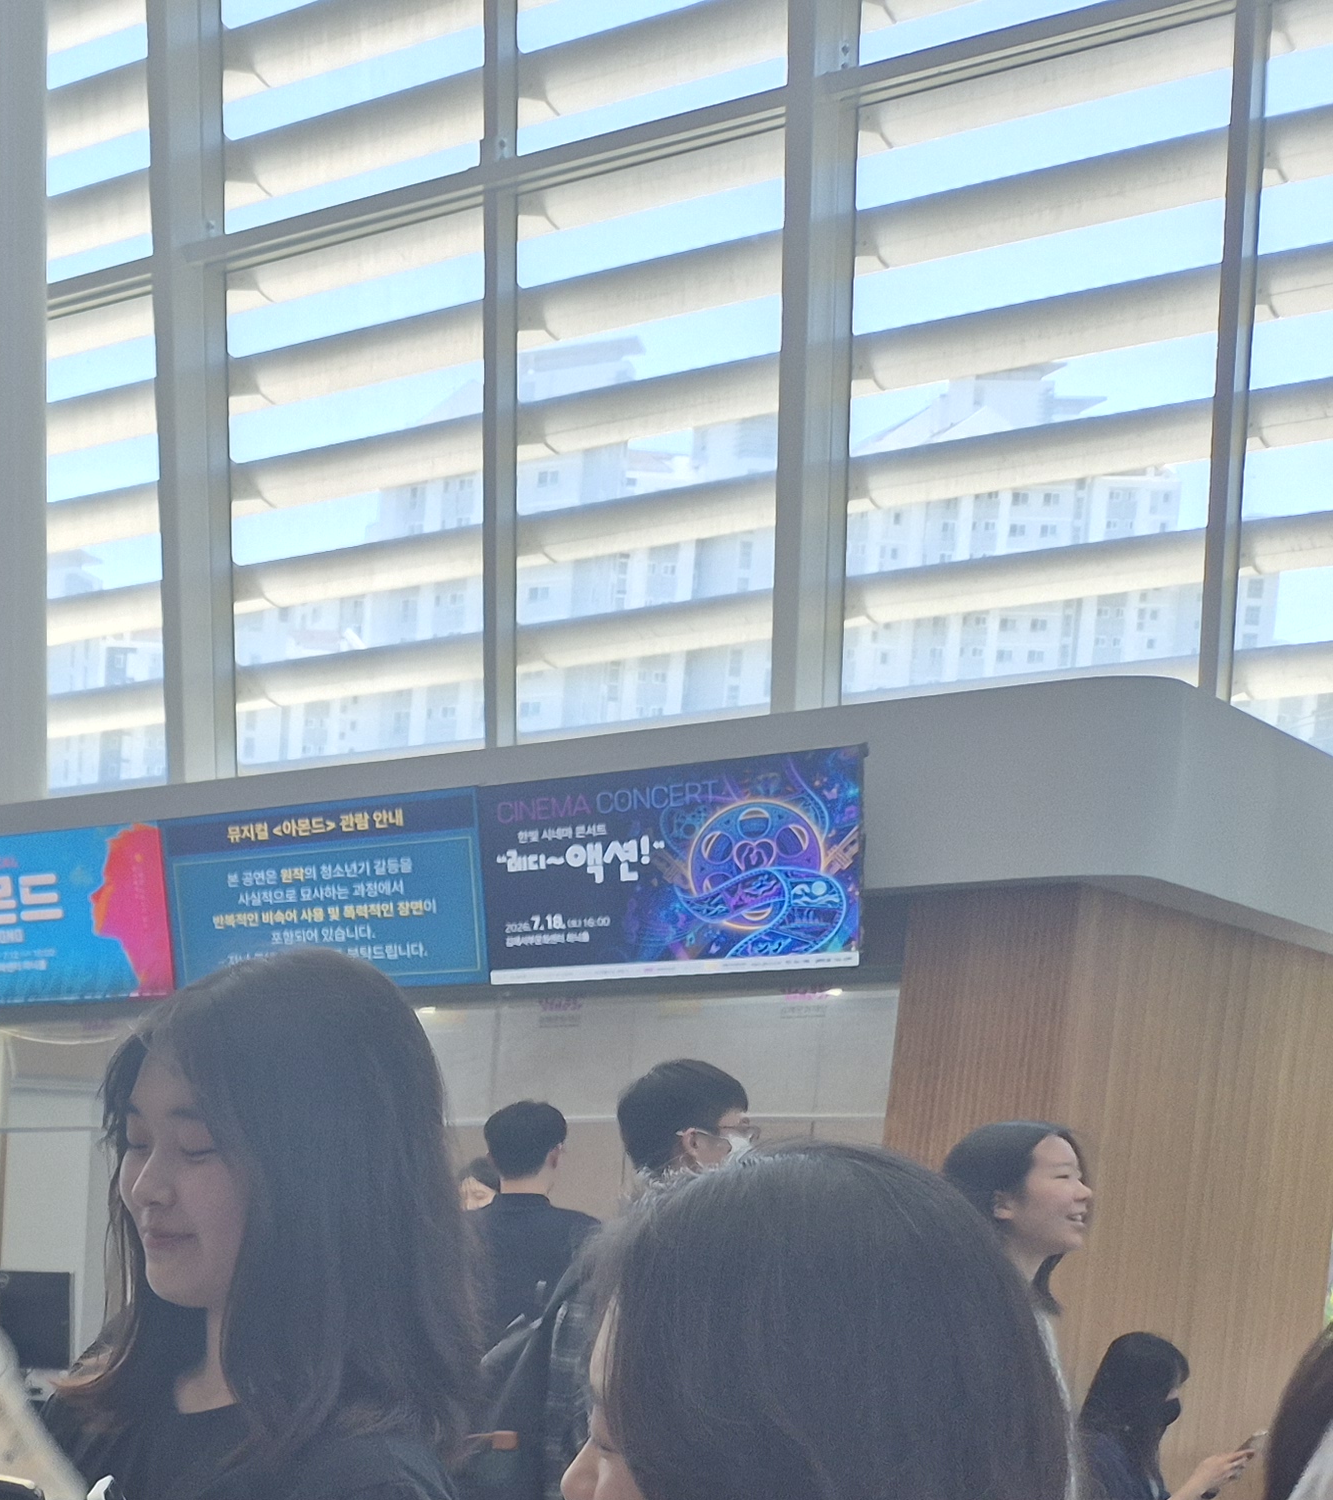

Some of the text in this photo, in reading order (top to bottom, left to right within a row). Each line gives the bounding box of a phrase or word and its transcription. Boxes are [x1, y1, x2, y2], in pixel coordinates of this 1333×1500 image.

[496, 780, 719, 824] CINEMA CONCERT
[227, 807, 404, 844] 뮤지컬 <아몬드> 관람 안내
[575, 823, 608, 838] 콘서트
[227, 856, 413, 888] 본 공연은 원작의 청소년기 갈등을
[238, 879, 404, 906] 사실적으로 묘사하는 과정에서
[213, 897, 437, 929] 반복적인 비속어 사용 및 폭력적인 장면이
[271, 923, 376, 945] 포함되어 있습니다.
